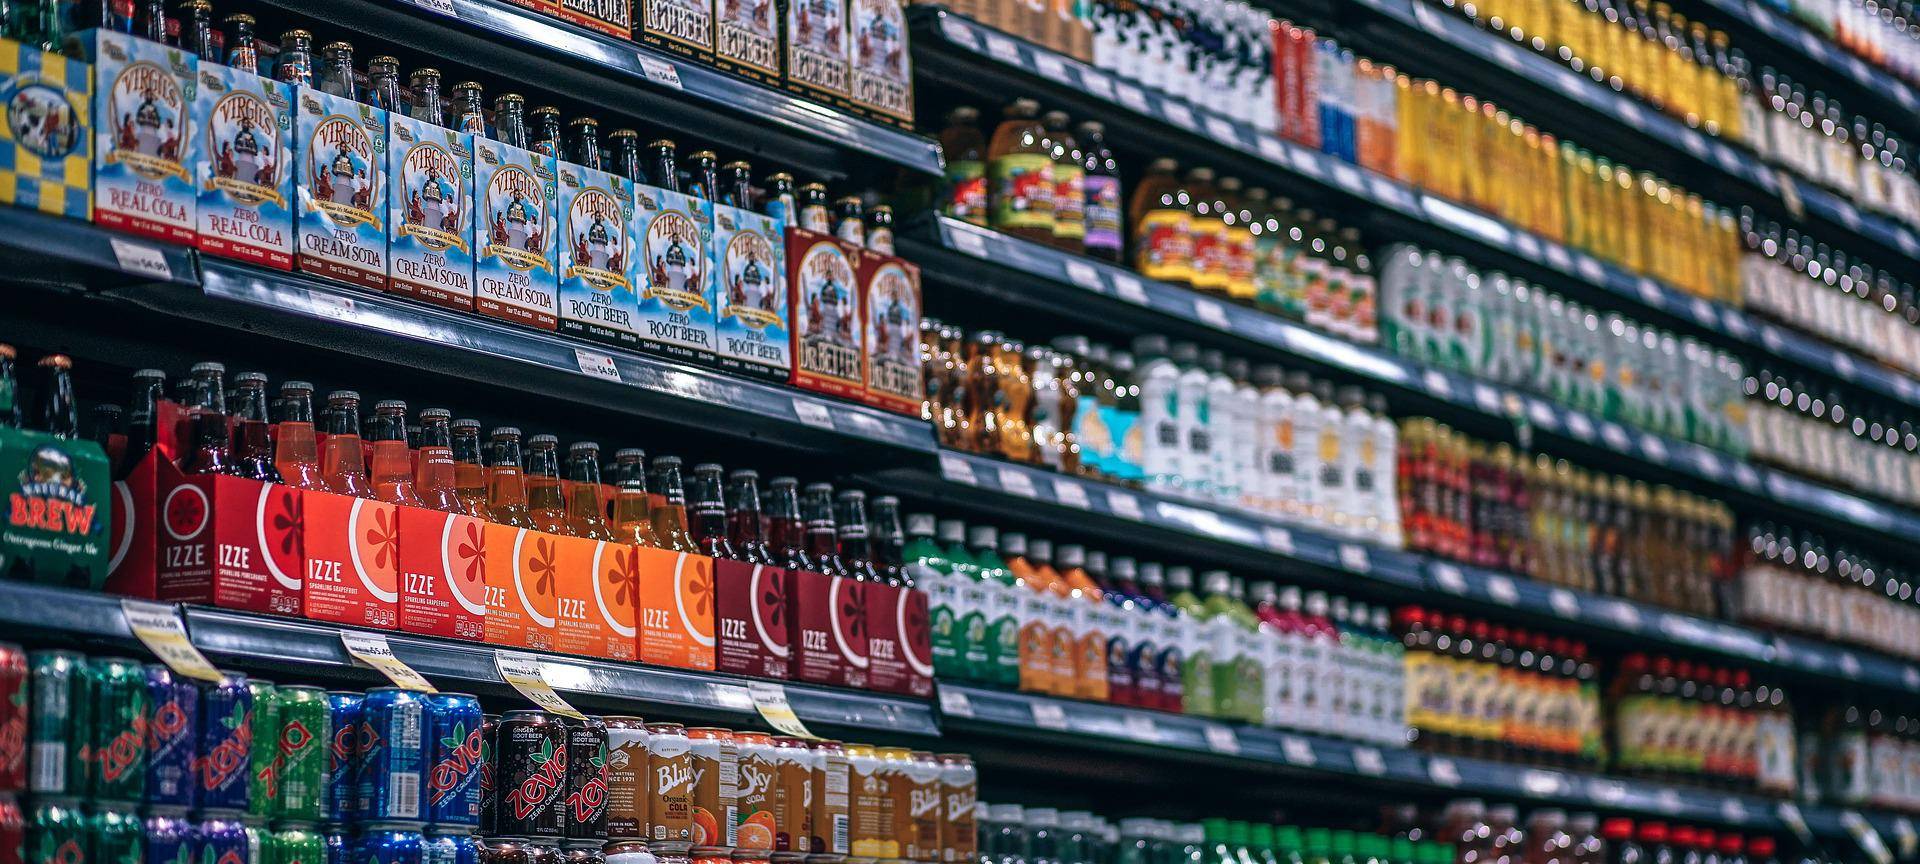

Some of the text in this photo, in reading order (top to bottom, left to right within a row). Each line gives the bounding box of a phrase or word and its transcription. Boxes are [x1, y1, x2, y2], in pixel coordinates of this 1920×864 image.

[221, 97, 273, 135] VIRGIL'S
[319, 121, 368, 159] VIRGIL'S
[410, 149, 455, 184] VIRGIL'S
[136, 180, 163, 197] ZERO
[494, 169, 540, 206] VIRGIL'S
[108, 188, 187, 221] REAL COLA
[233, 207, 259, 222] ZERO
[576, 191, 620, 228] VIRGIL'S
[208, 214, 247, 238] REAL
[249, 223, 283, 246] COLA
[333, 228, 357, 244] ZERO
[654, 215, 697, 248] VIRGIL'S
[305, 233, 381, 268] CREAM SODA
[423, 252, 446, 267] ZERO
[397, 258, 468, 290] CREAM SODA
[508, 272, 530, 287] ZERO
[482, 278, 553, 309] CREAM SODA
[591, 292, 612, 306] ZERO
[569, 300, 633, 329] ROOT BEER
[668, 312, 690, 325] ZERO
[647, 320, 710, 348] ROOT BEER
[746, 329, 766, 344] ZERO
[726, 337, 757, 356] ROOT
[756, 344, 784, 365] BEER
[597, 365, 618, 376] $4.99
[9, 492, 96, 535] BREW
[53, 538, 82, 554] Ginger
[83, 542, 98, 555] Ale
[166, 544, 205, 567] IZZE
[219, 543, 250, 568] IZZE
[309, 559, 342, 583] IZZE
[309, 582, 358, 595] SPARKLING GRAPEFRUIT
[405, 572, 435, 596] IZZE
[405, 595, 450, 607] SPARKLING GRAPEFRUIT
[484, 586, 506, 608] ZZE
[558, 597, 586, 619] IZZE
[644, 608, 669, 629] IZZE
[721, 618, 747, 639] IZZE
[802, 629, 828, 651] IZZE
[737, 764, 772, 798] Sky
[438, 791, 457, 808] ZERO
[663, 795, 688, 803] Organic
[669, 803, 688, 811] COLA
[746, 794, 765, 804] SODA
[528, 804, 546, 820] ZERO
[589, 808, 603, 824] ZERO
